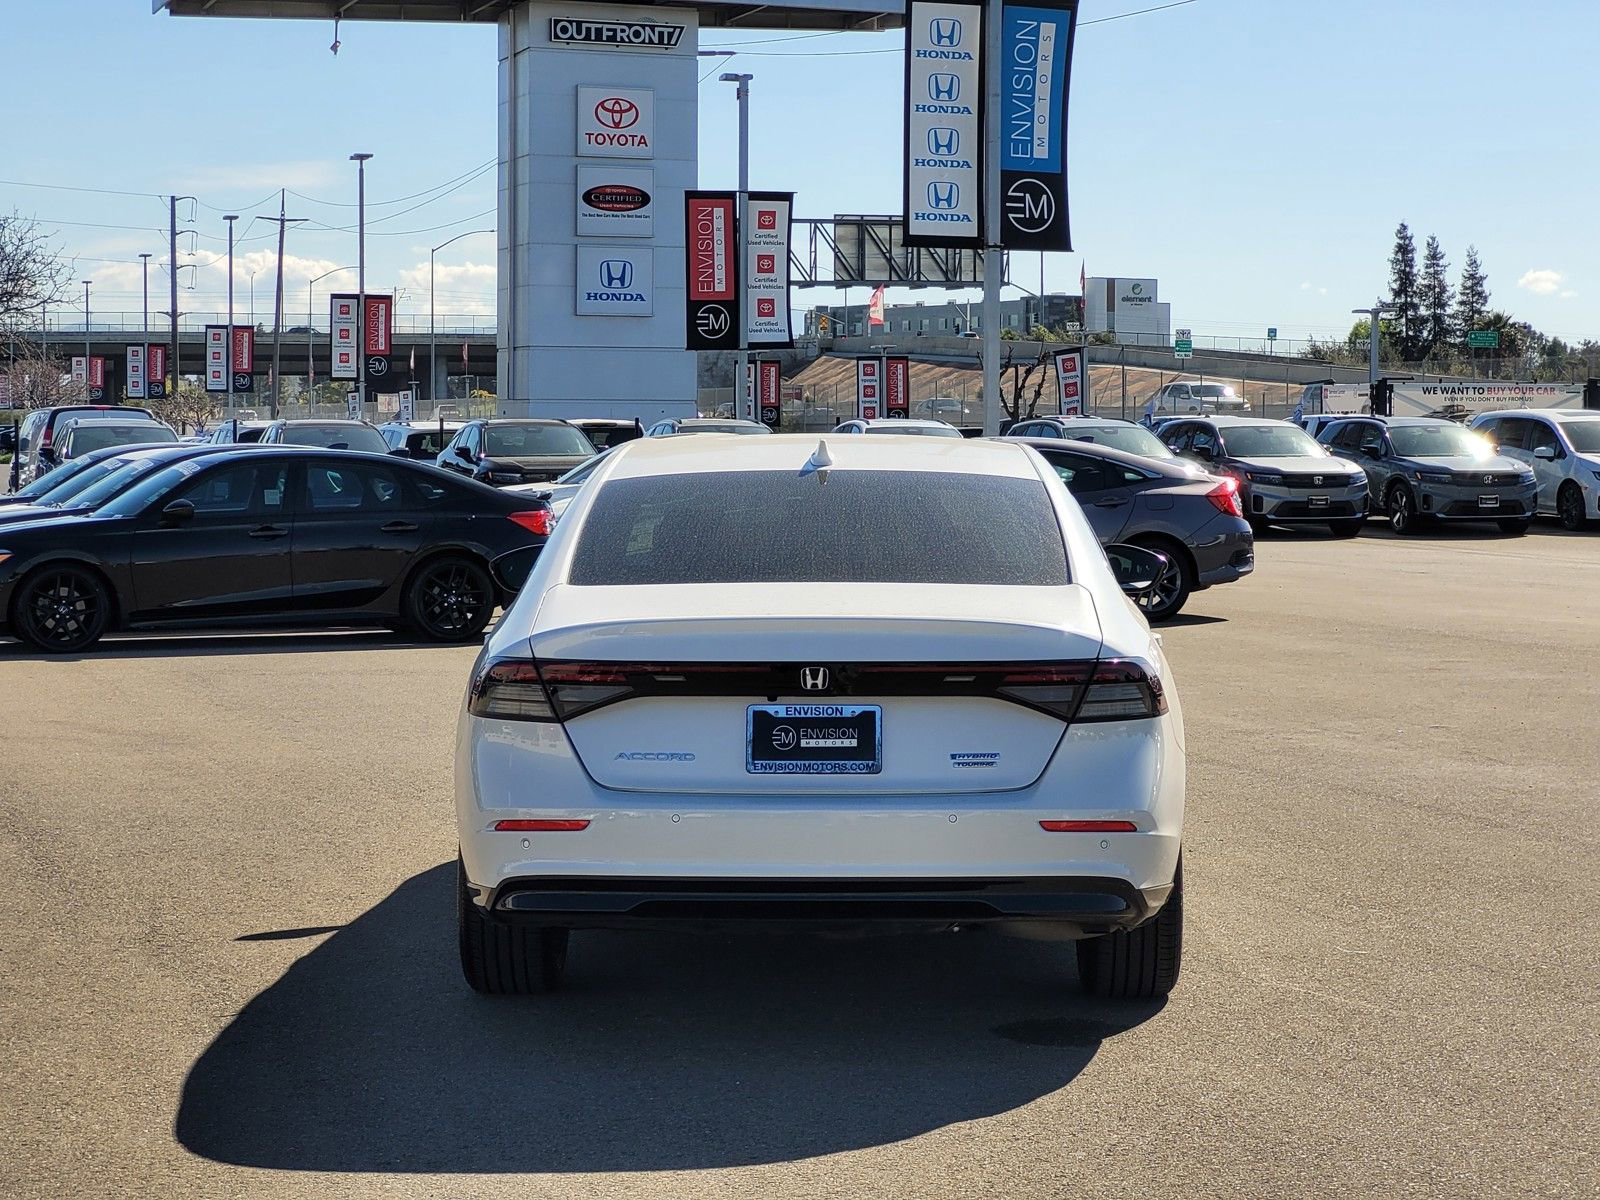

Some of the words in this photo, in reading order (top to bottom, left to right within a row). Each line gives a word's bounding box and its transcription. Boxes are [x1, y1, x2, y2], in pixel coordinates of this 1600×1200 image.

[915, 49, 974, 61] HONDA
[1010, 20, 1038, 158] ENVISION
[1037, 35, 1051, 147] MOTORS
[914, 104, 973, 115] HONDA
[585, 133, 648, 147] TOYOTA
[914, 159, 972, 169] HONDA
[914, 212, 973, 223] HONDA
[697, 207, 714, 292] ENVISION
[715, 215, 724, 285] MOTORS
[585, 292, 647, 302] HONDA
[1121, 295, 1153, 303] element
[369, 303, 379, 351] ENVISION
[236, 331, 244, 369] ENVISION
[763, 366, 771, 404] ENVISION
[890, 363, 898, 405] ENVISION
[1422, 386, 1438, 395] WE
[1440, 386, 1470, 395] WANT
[1472, 386, 1485, 395] TO
[1487, 387, 1506, 395] BUY
[1508, 387, 1534, 395] YOUR
[1536, 387, 1556, 396] CAR
[785, 706, 844, 716] ENVISION
[800, 728, 858, 739] ENVISION
[614, 752, 696, 761] ACCORD
[753, 762, 875, 772] ENVISIONMOTORS.COM
